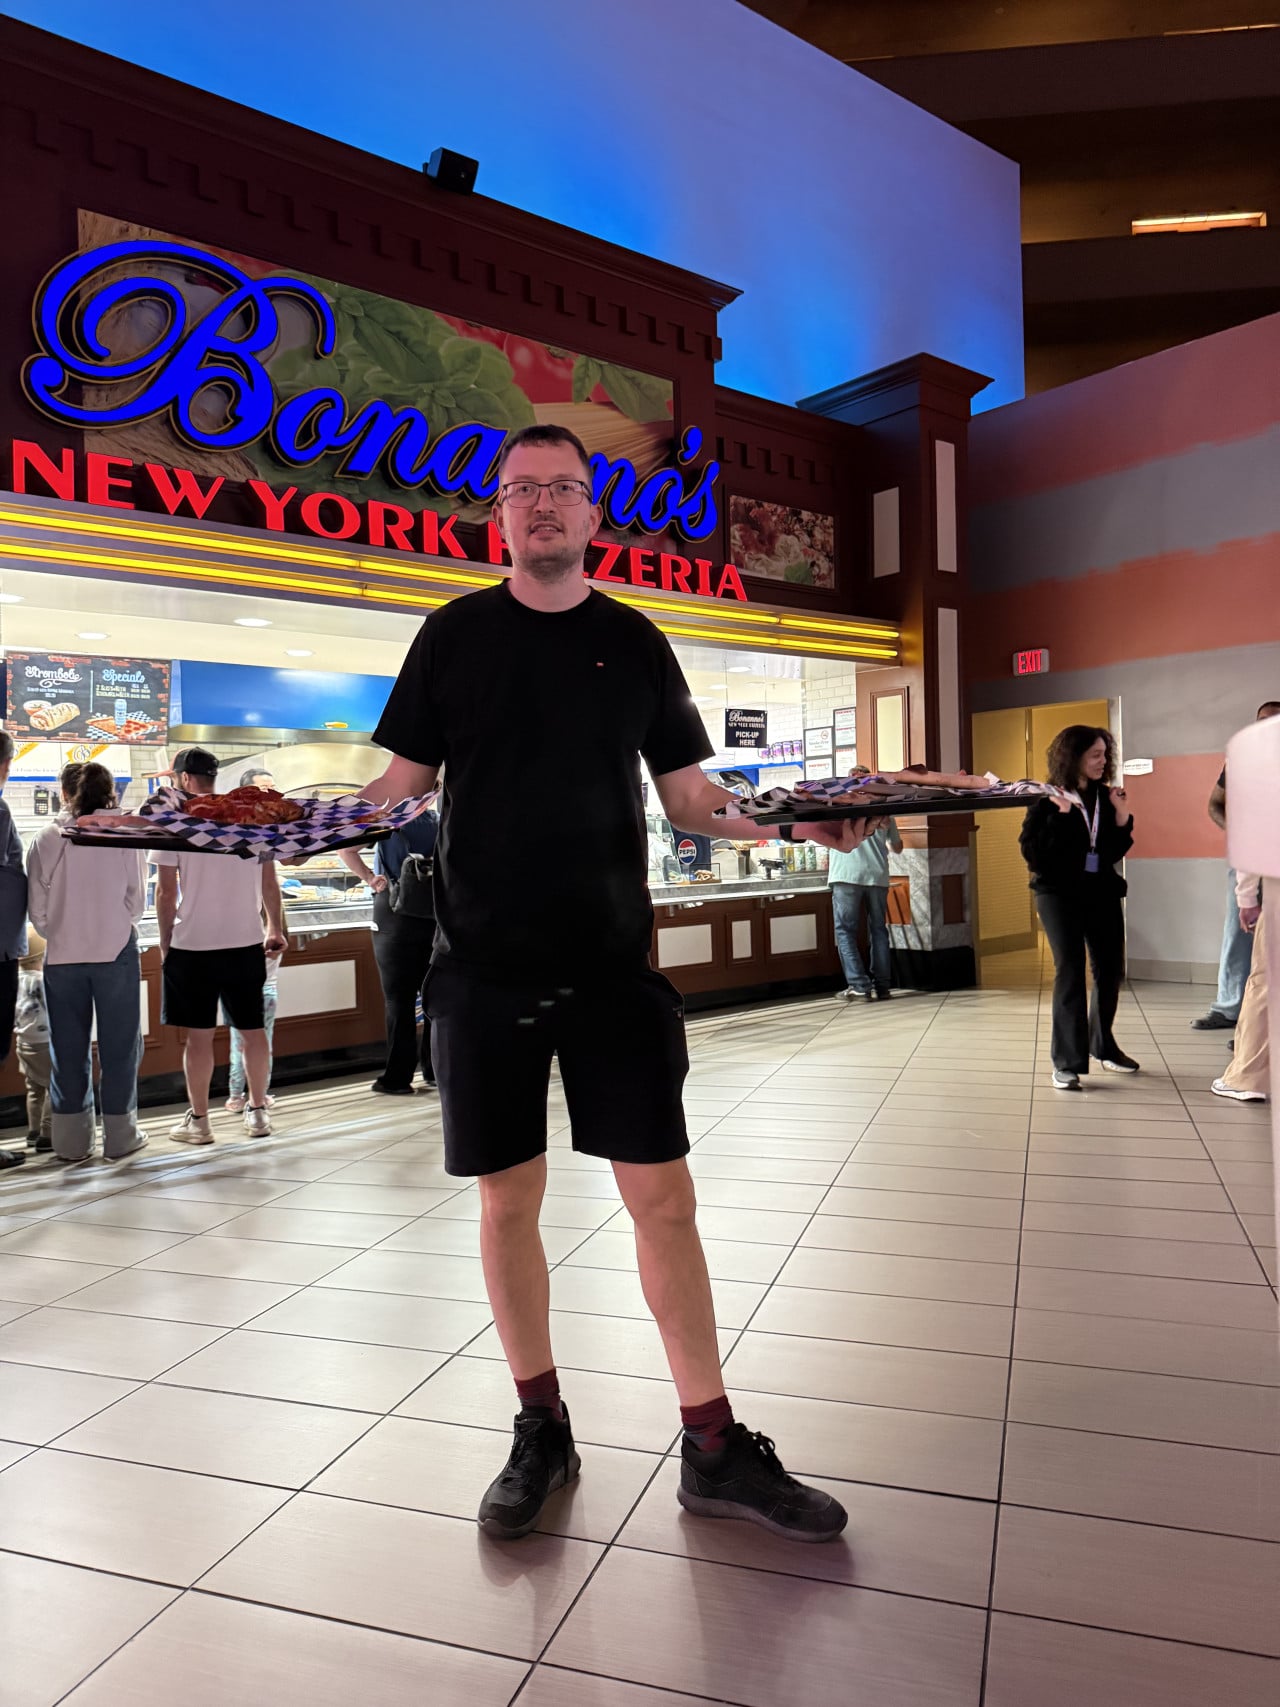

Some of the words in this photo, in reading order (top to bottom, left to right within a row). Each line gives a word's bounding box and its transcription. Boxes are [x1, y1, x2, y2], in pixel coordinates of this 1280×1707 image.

[27, 239, 720, 540] Bonano's
[12, 438, 226, 520] NEW
[248, 479, 469, 560] YORK
[102, 669, 145, 685] Specials
[1017, 650, 1042, 674] EXIT
